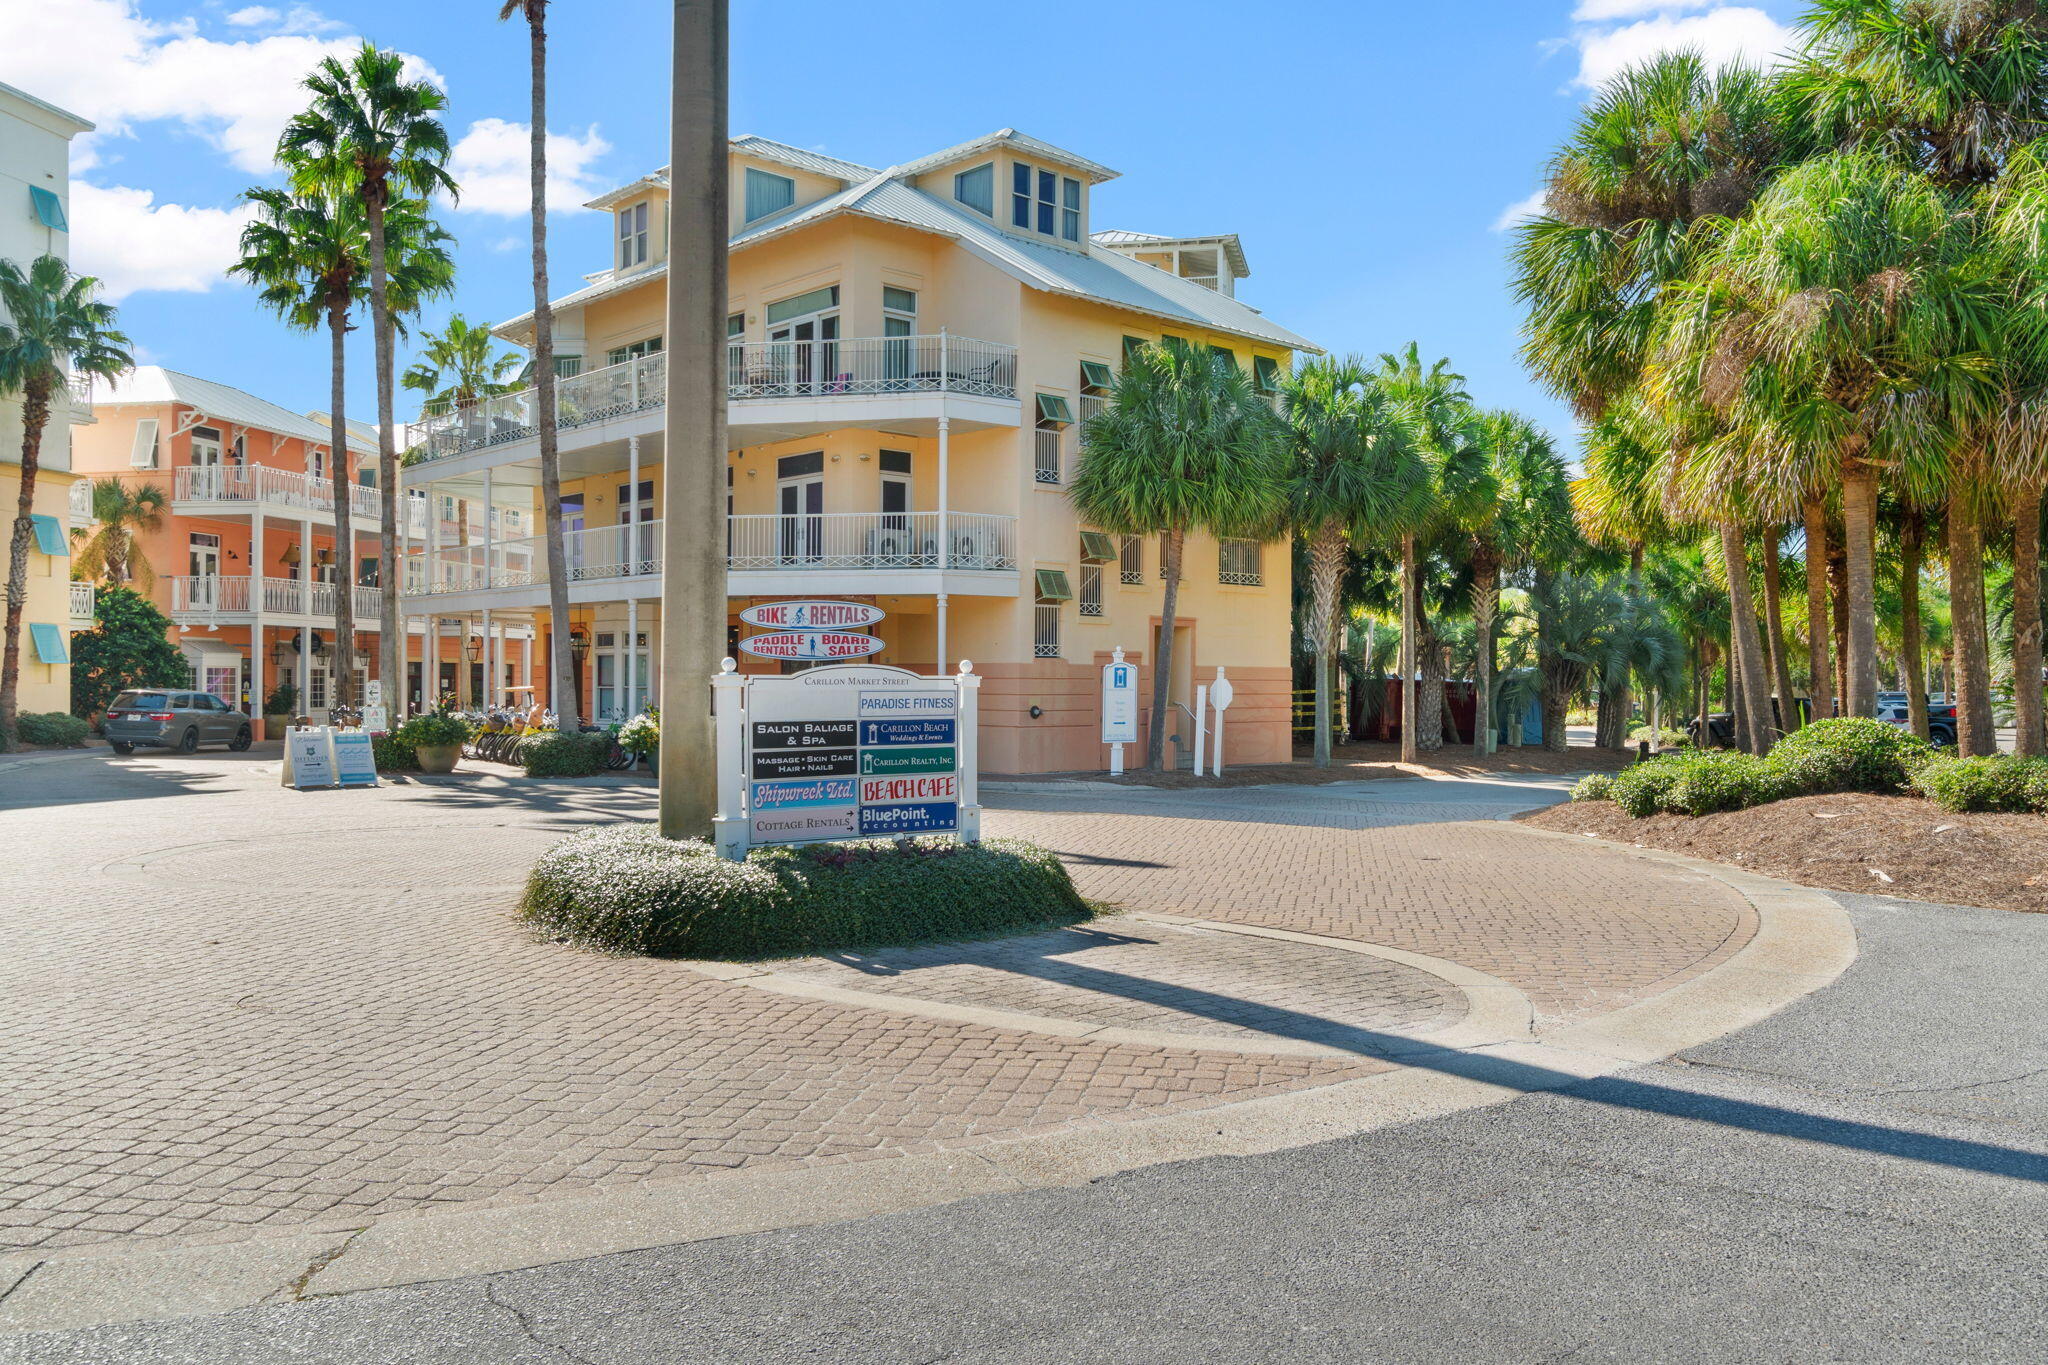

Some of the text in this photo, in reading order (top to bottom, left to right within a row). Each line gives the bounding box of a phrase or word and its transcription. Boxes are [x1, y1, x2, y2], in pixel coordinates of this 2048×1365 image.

[756, 606, 870, 624] BIKE RENTALS
[754, 634, 870, 645] PADDLE BOARD
[754, 646, 870, 656] RENTALS SALES
[861, 698, 954, 710] PARADISE FITNESS
[758, 725, 799, 734] SALON
[787, 736, 826, 745] & SPA
[864, 776, 954, 801] BEACH CAFE
[754, 781, 854, 808] Shipwreck Ltd.
[862, 808, 930, 822] BluePoint.
[862, 819, 954, 830] Accounting
